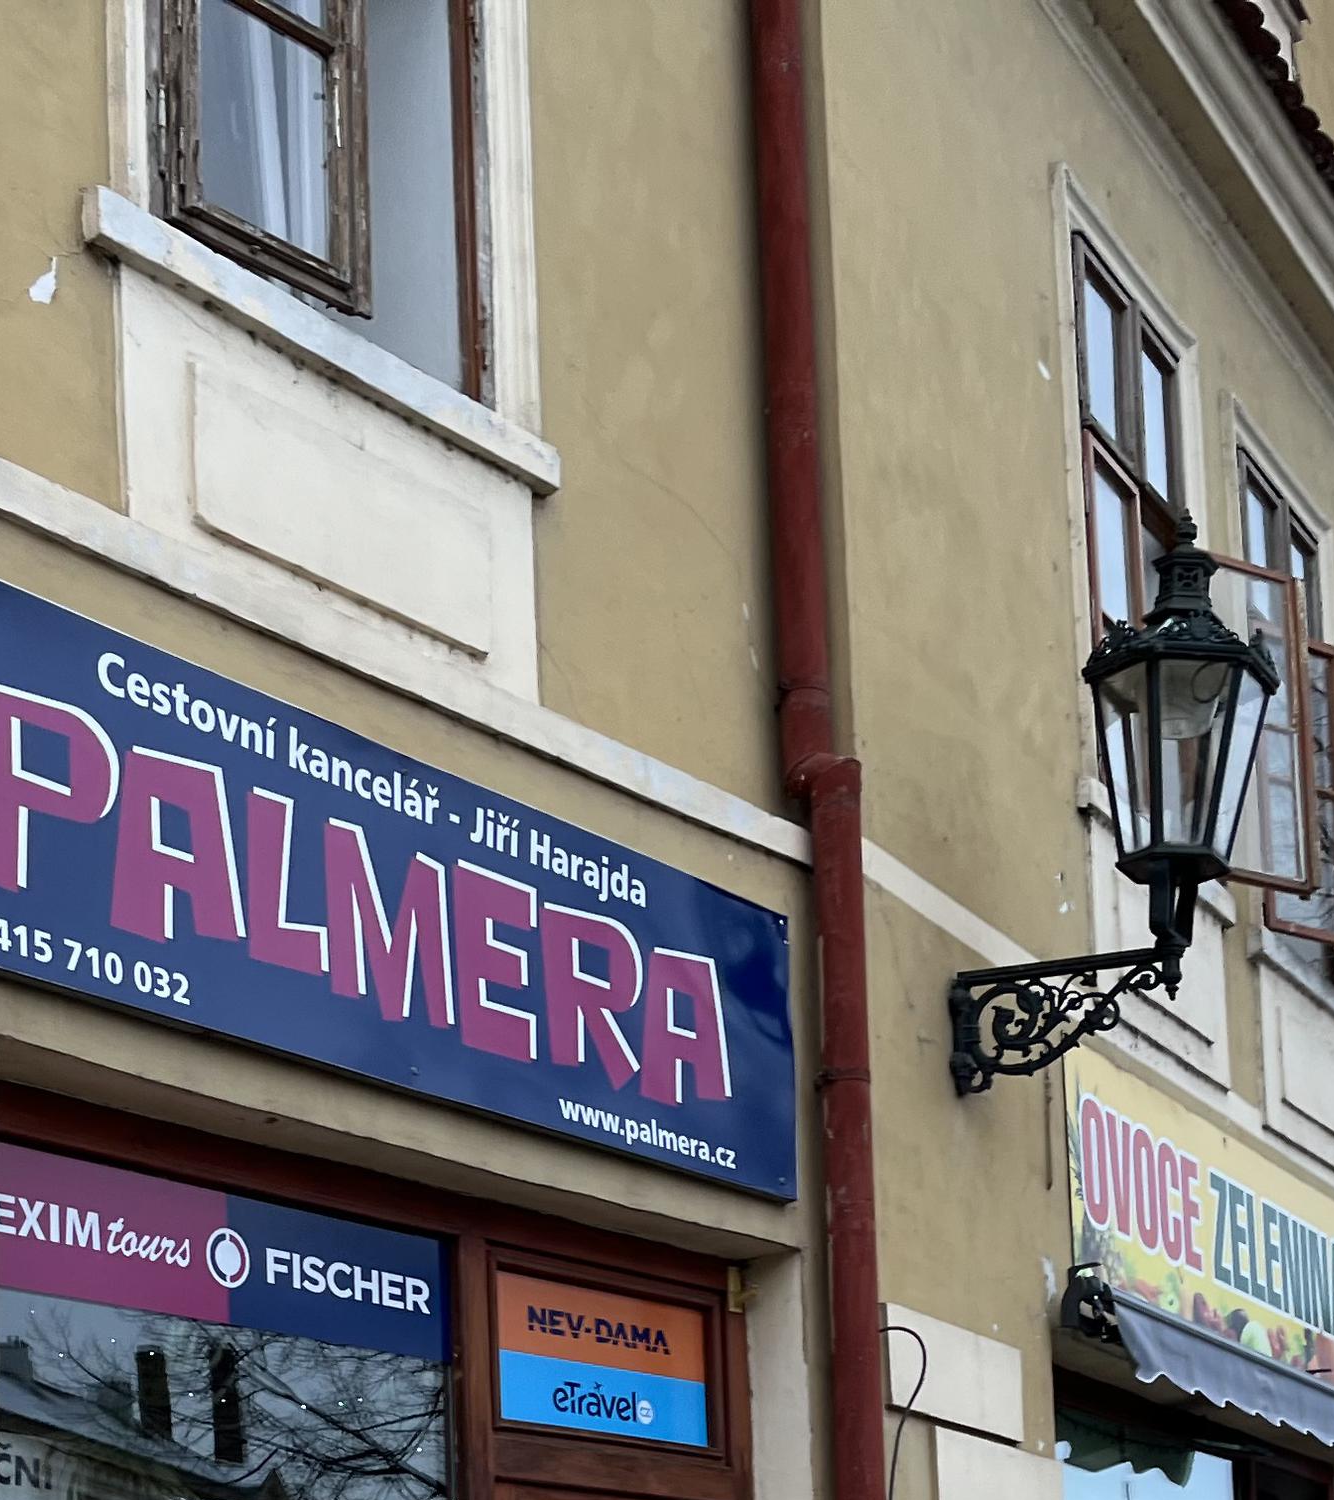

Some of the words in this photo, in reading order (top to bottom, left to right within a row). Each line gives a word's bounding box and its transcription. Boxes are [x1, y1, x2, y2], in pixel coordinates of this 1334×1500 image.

[96, 651, 276, 760] Cestovní
[287, 725, 441, 825] kancelář
[448, 813, 461, 824] -
[469, 806, 519, 858] Jiří
[529, 828, 648, 908] Harajda
[63, 937, 124, 985] 710
[133, 960, 191, 1006] 032
[558, 1098, 737, 1169] www.palmera.cz
[1079, 1096, 1204, 1274] OVOCE
[265, 1247, 431, 1315] FISCHER
[526, 1304, 671, 1356] NEV-DAMA
[552, 1380, 637, 1422] eTravel
